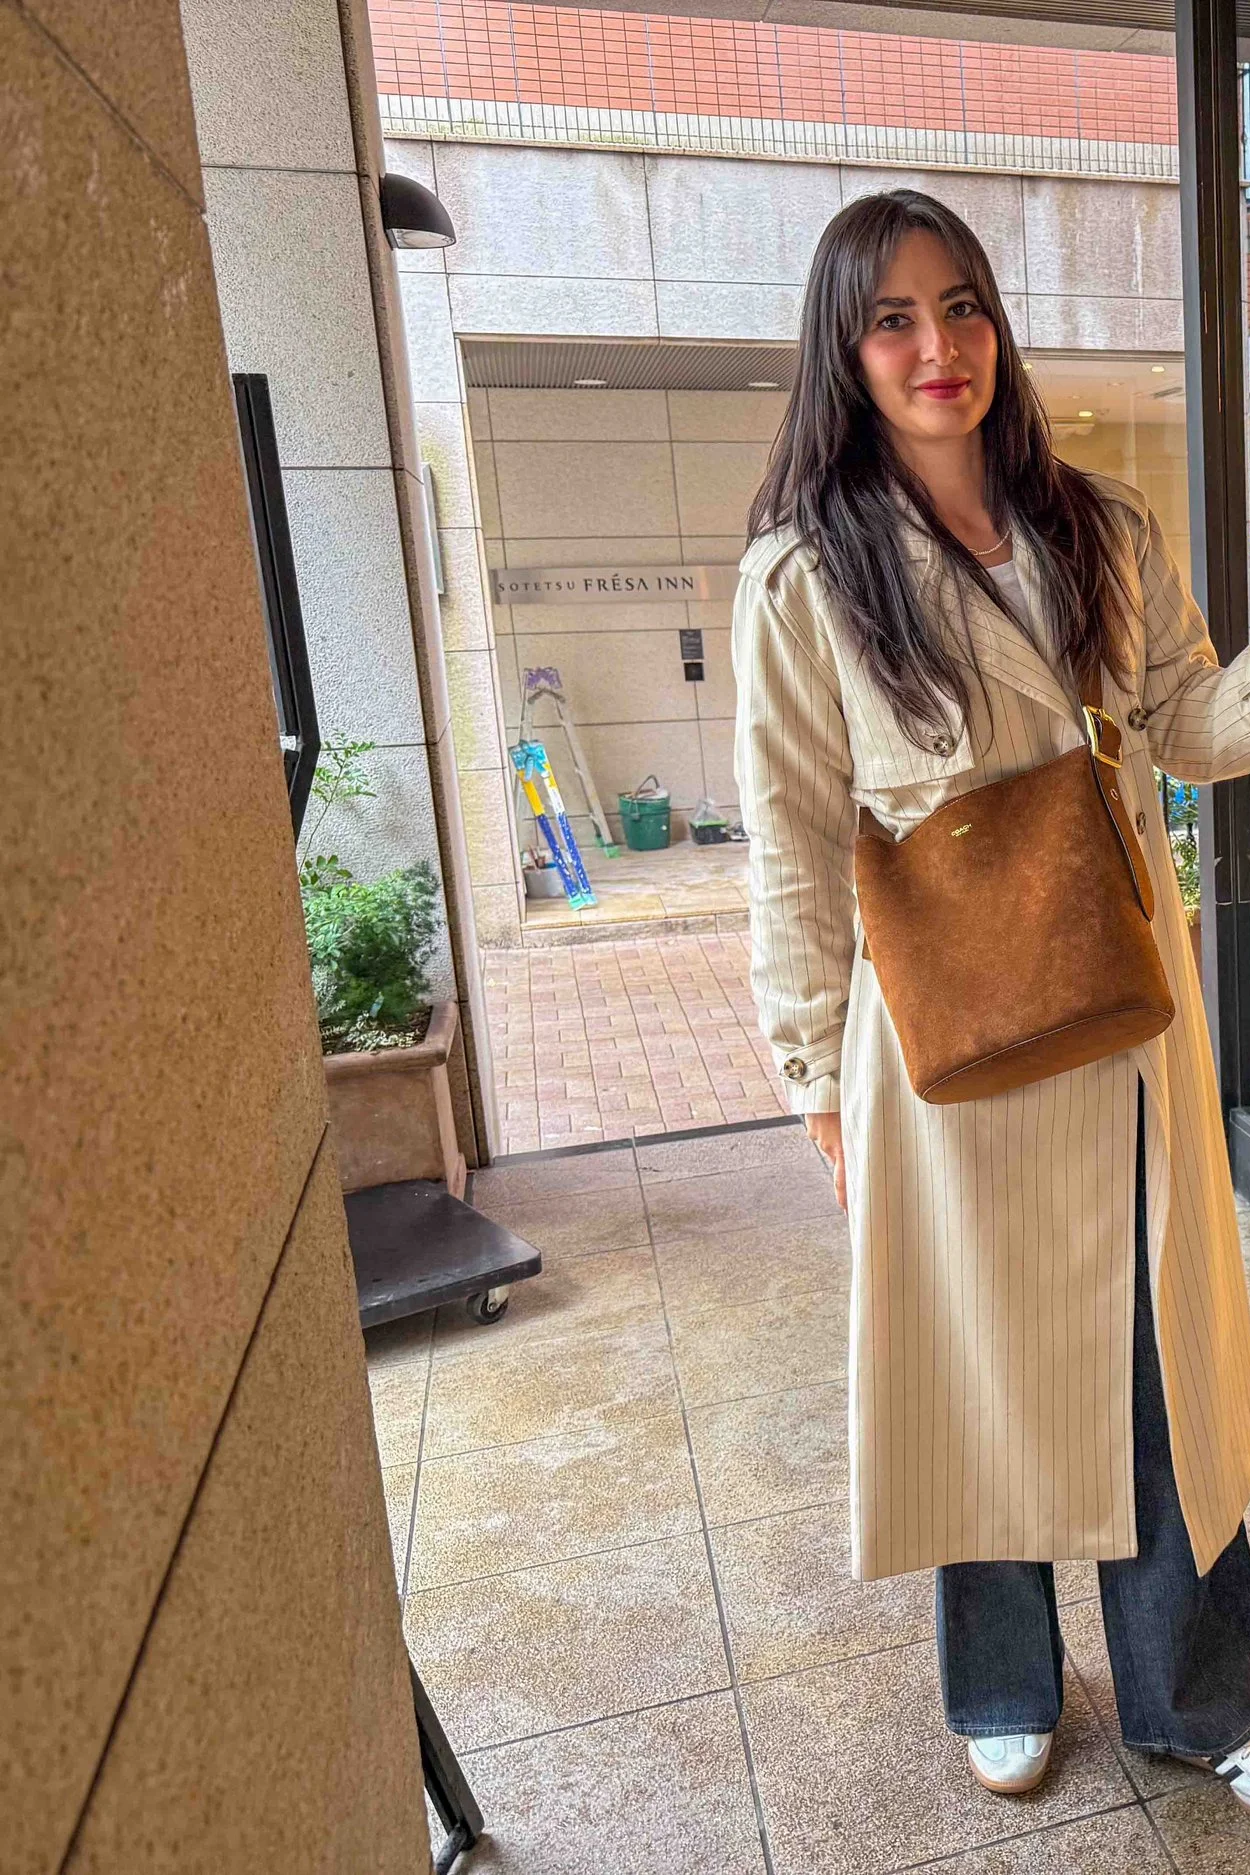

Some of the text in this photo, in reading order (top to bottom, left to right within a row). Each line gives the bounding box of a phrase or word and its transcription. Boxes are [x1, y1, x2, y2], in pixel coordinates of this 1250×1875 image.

[498, 573, 694, 592] SOTETSU FRÉSA INN
[951, 823, 972, 837] COACH
